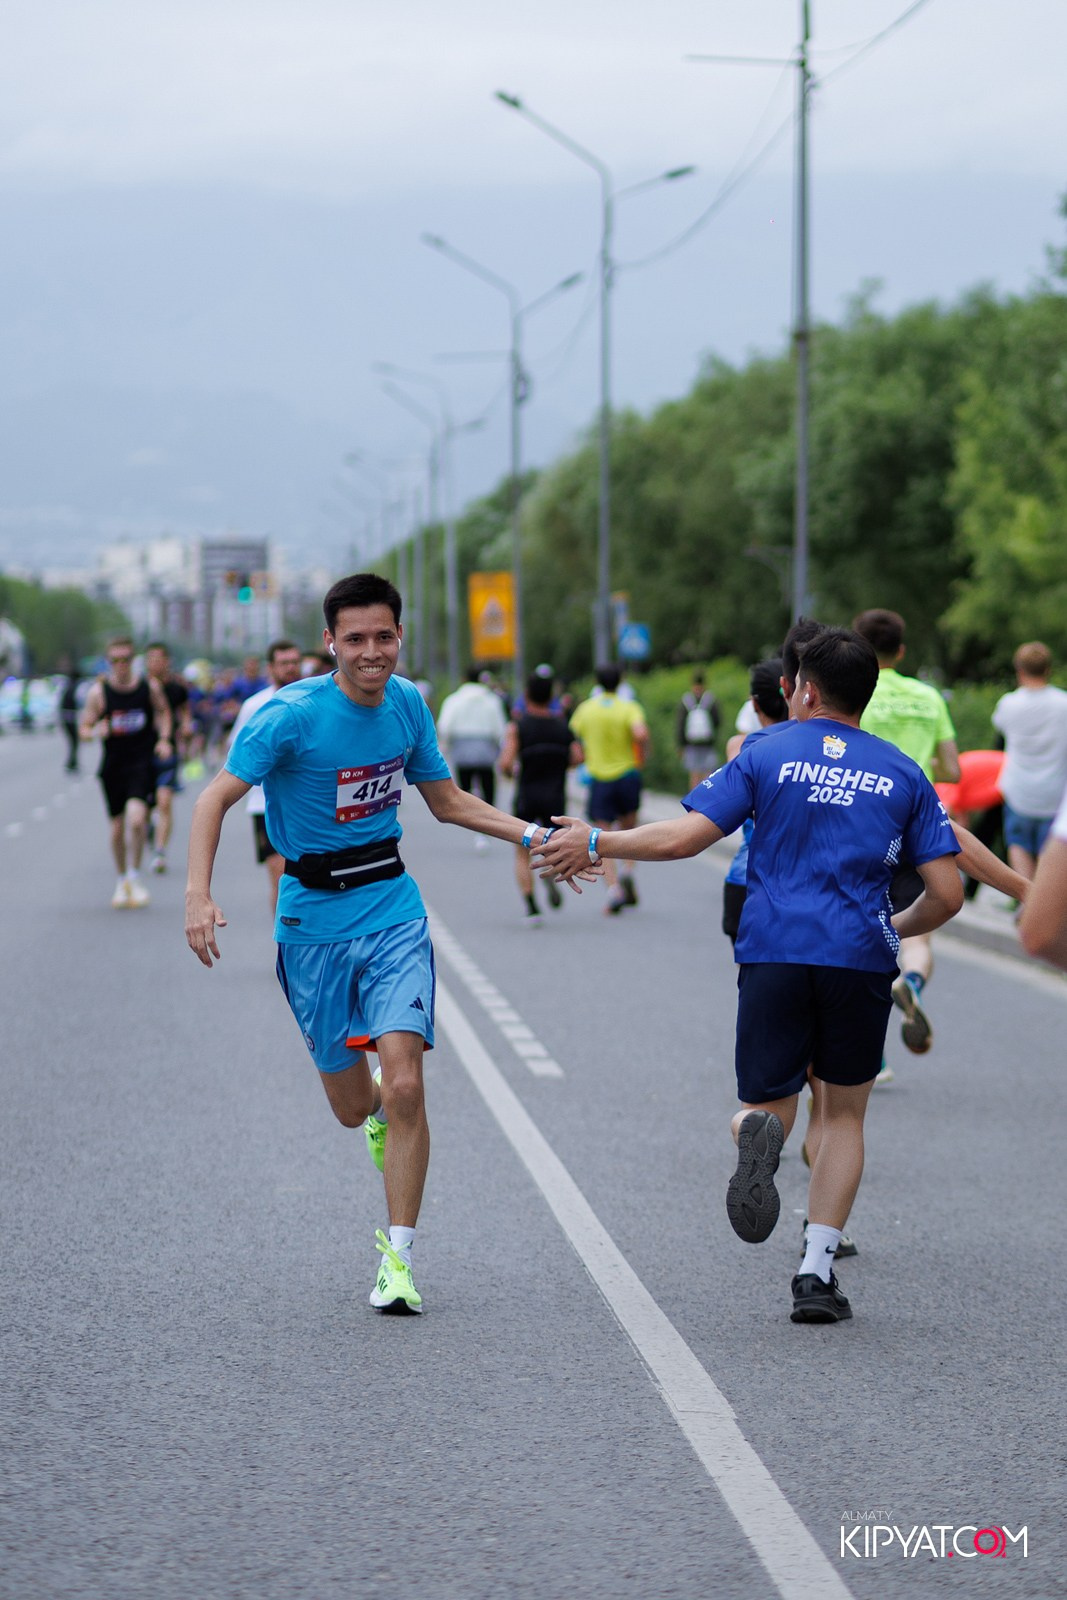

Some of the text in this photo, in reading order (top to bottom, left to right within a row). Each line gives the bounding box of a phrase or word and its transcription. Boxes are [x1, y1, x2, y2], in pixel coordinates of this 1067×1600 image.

[341, 770, 364, 779] 10 KM
[778, 761, 894, 797] FINISHER
[352, 774, 393, 802] 414
[807, 785, 856, 807] 2025
